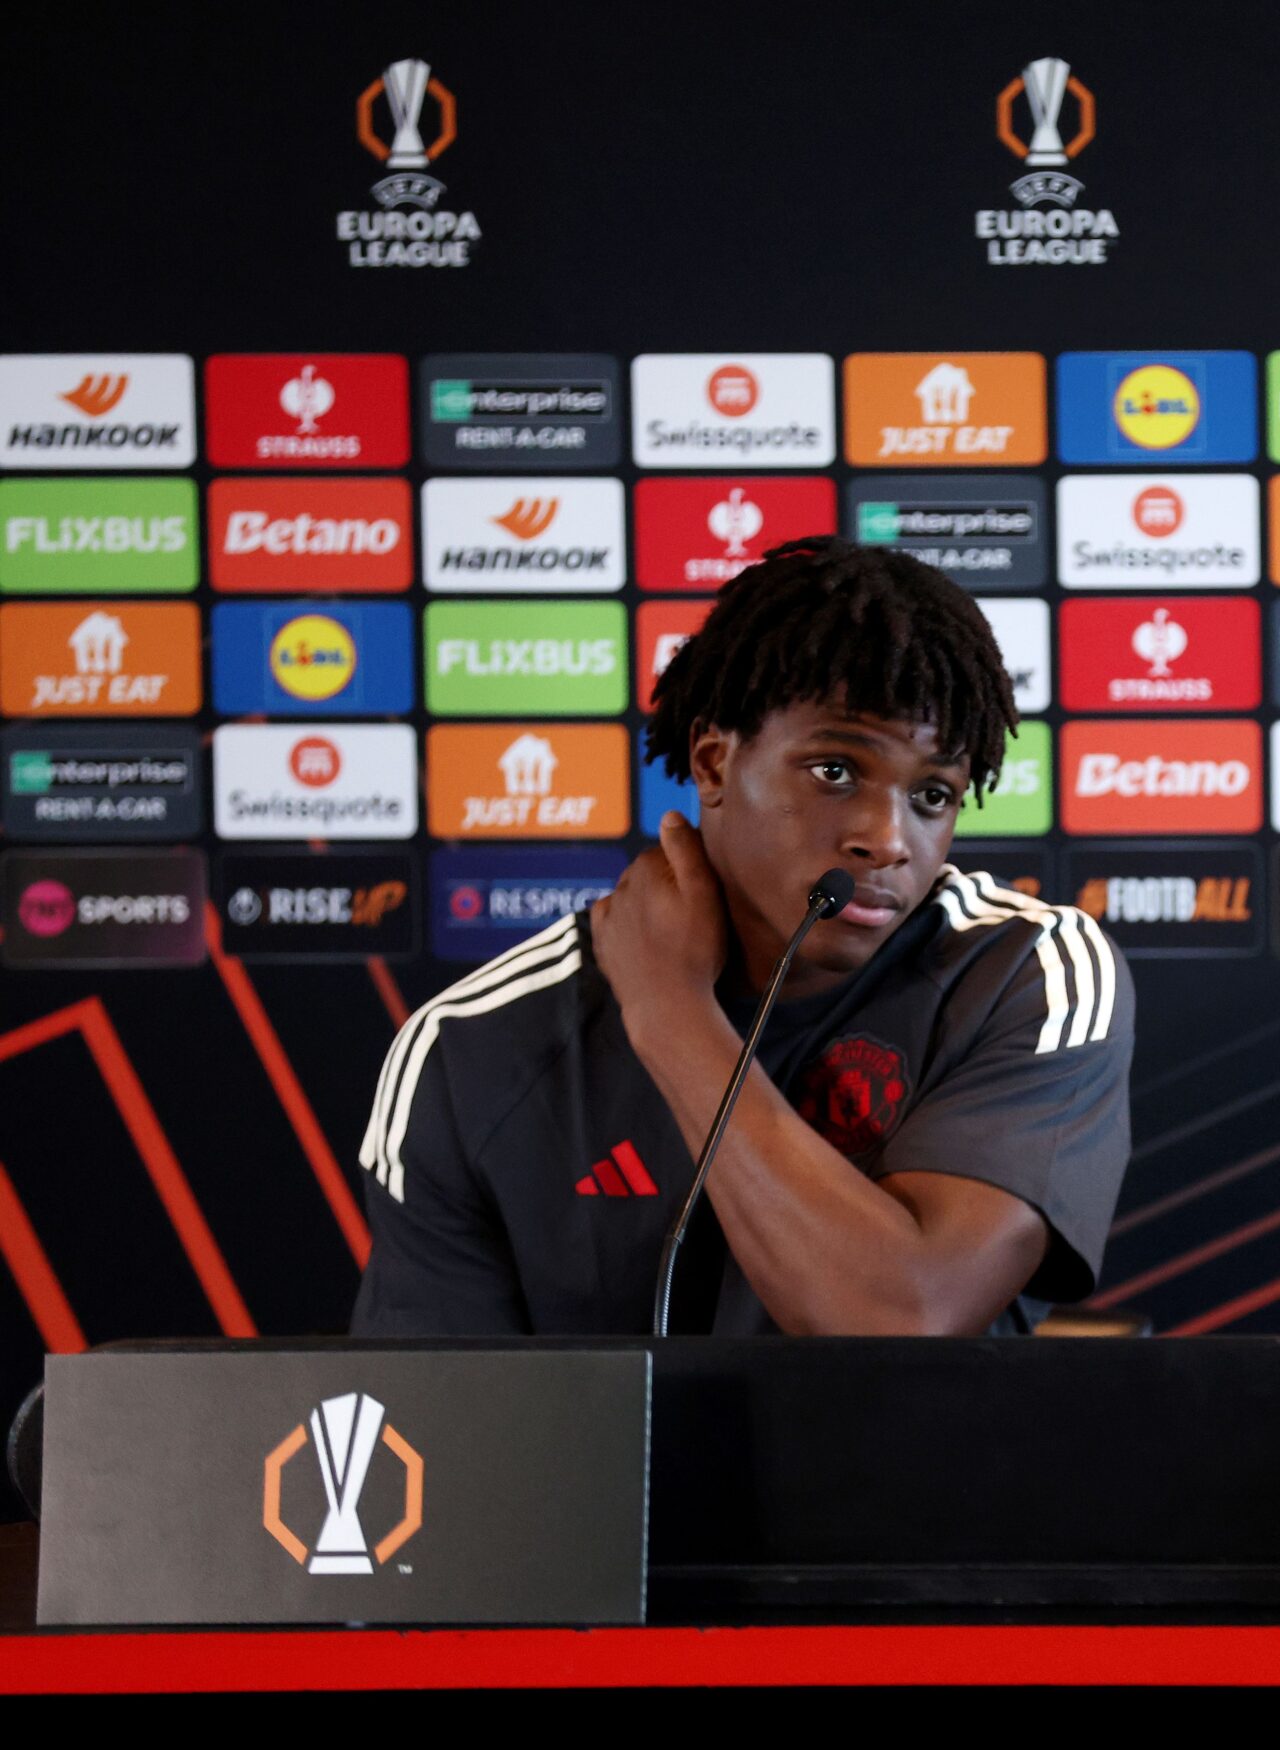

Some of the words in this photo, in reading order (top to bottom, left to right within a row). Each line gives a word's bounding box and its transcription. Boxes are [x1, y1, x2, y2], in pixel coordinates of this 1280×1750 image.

[336, 210, 482, 243] EUROPA
[975, 209, 1120, 242] EUROPA
[349, 239, 469, 268] LEAGUE
[987, 238, 1107, 265] LEAGUE
[256, 435, 361, 458] STRAUSS
[646, 415, 821, 453] Swissquote
[878, 427, 954, 456] JUST
[956, 425, 1013, 454] EAT
[223, 510, 401, 555] Betano
[685, 558, 768, 581] STRA
[1072, 537, 1245, 574] Swissquote
[32, 675, 109, 705] JUST
[110, 674, 167, 704] EAT
[1109, 678, 1213, 701] STRAUSS
[1075, 753, 1250, 797] Betano
[228, 787, 402, 825] Swissquote
[462, 800, 539, 827] JUST
[544, 798, 597, 826] EAT
[77, 895, 190, 924] SPORTS
[1077, 877, 1252, 922] #FOOTBALL
